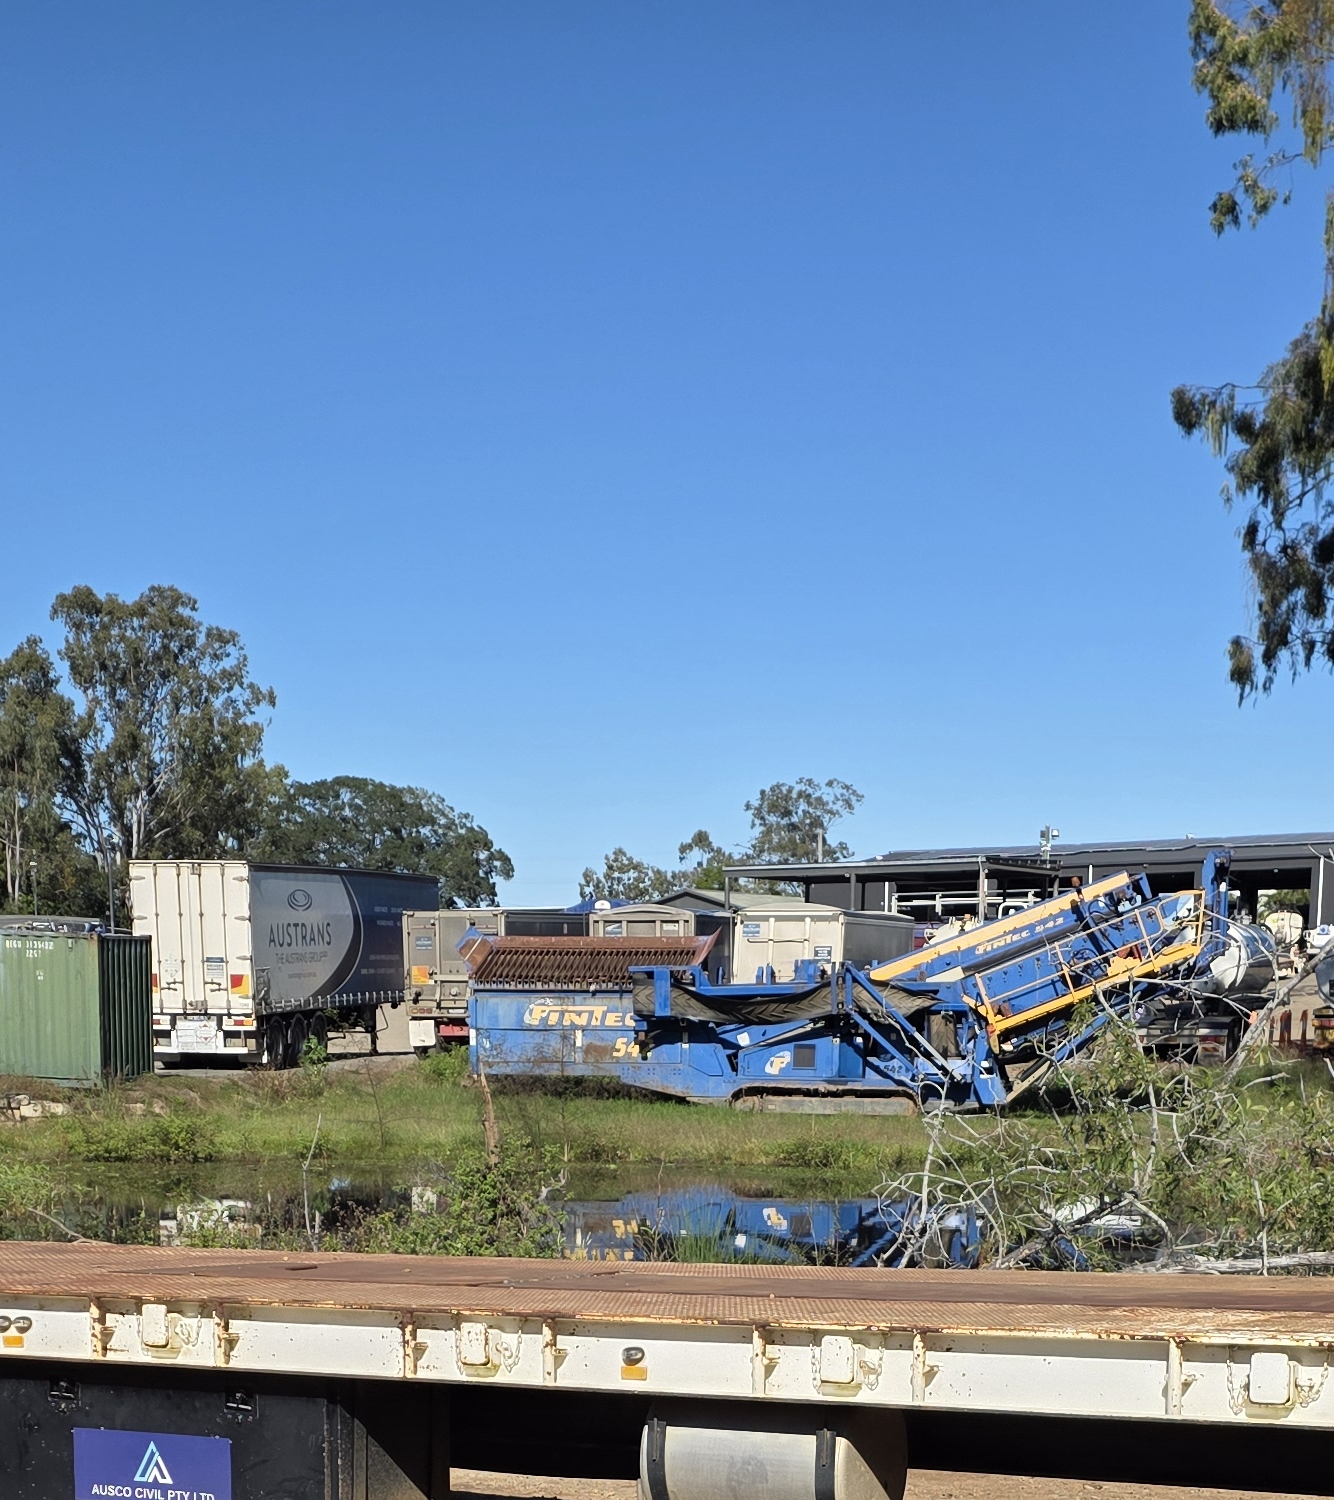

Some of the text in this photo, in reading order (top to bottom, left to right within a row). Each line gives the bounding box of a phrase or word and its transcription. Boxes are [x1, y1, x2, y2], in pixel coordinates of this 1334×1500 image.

[268, 922, 332, 948] AUSTRANS
[613, 1037, 642, 1058] 54
[91, 1483, 131, 1498] AUSCO
[134, 1487, 165, 1500] CIVIL
